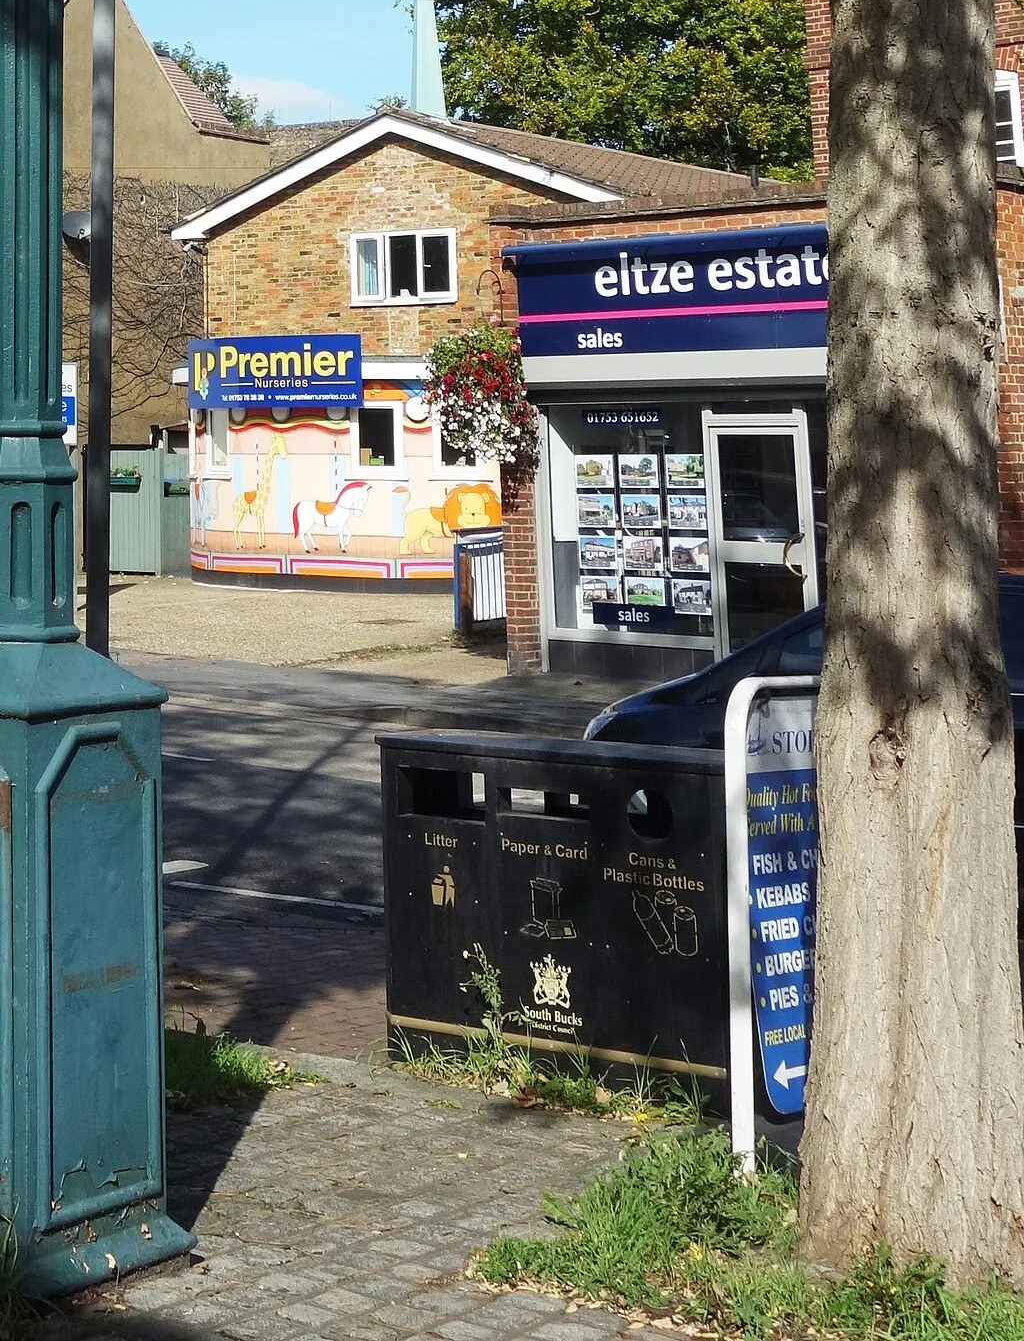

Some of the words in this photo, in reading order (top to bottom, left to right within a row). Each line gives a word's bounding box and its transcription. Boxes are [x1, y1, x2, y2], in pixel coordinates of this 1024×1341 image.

[577, 327, 623, 349] sales
[220, 343, 354, 378] Premier
[254, 377, 309, 388] Nurseries
[587, 411, 618, 424] 01753
[620, 411, 659, 423] 651652
[617, 607, 650, 623] sales
[781, 784, 798, 805] Hot
[780, 811, 804, 833] With
[424, 832, 459, 849] Litter
[501, 838, 540, 856] Paper
[544, 844, 553, 856] &
[555, 844, 588, 860] Card
[628, 851, 664, 869] Cans
[667, 857, 677, 870] &
[753, 852, 783, 876] FISH
[787, 850, 798, 871] &
[603, 866, 651, 886] Plastic
[652, 873, 705, 892] Bottles
[756, 881, 812, 909] KEBABS
[760, 916, 800, 943] FRIED
[769, 985, 800, 1011] PIES
[803, 982, 813, 1005] &
[525, 1005, 552, 1022] South
[554, 1010, 583, 1027] Bucks
[764, 1029, 783, 1048] FREE
[785, 1023, 807, 1044] LOCAL
